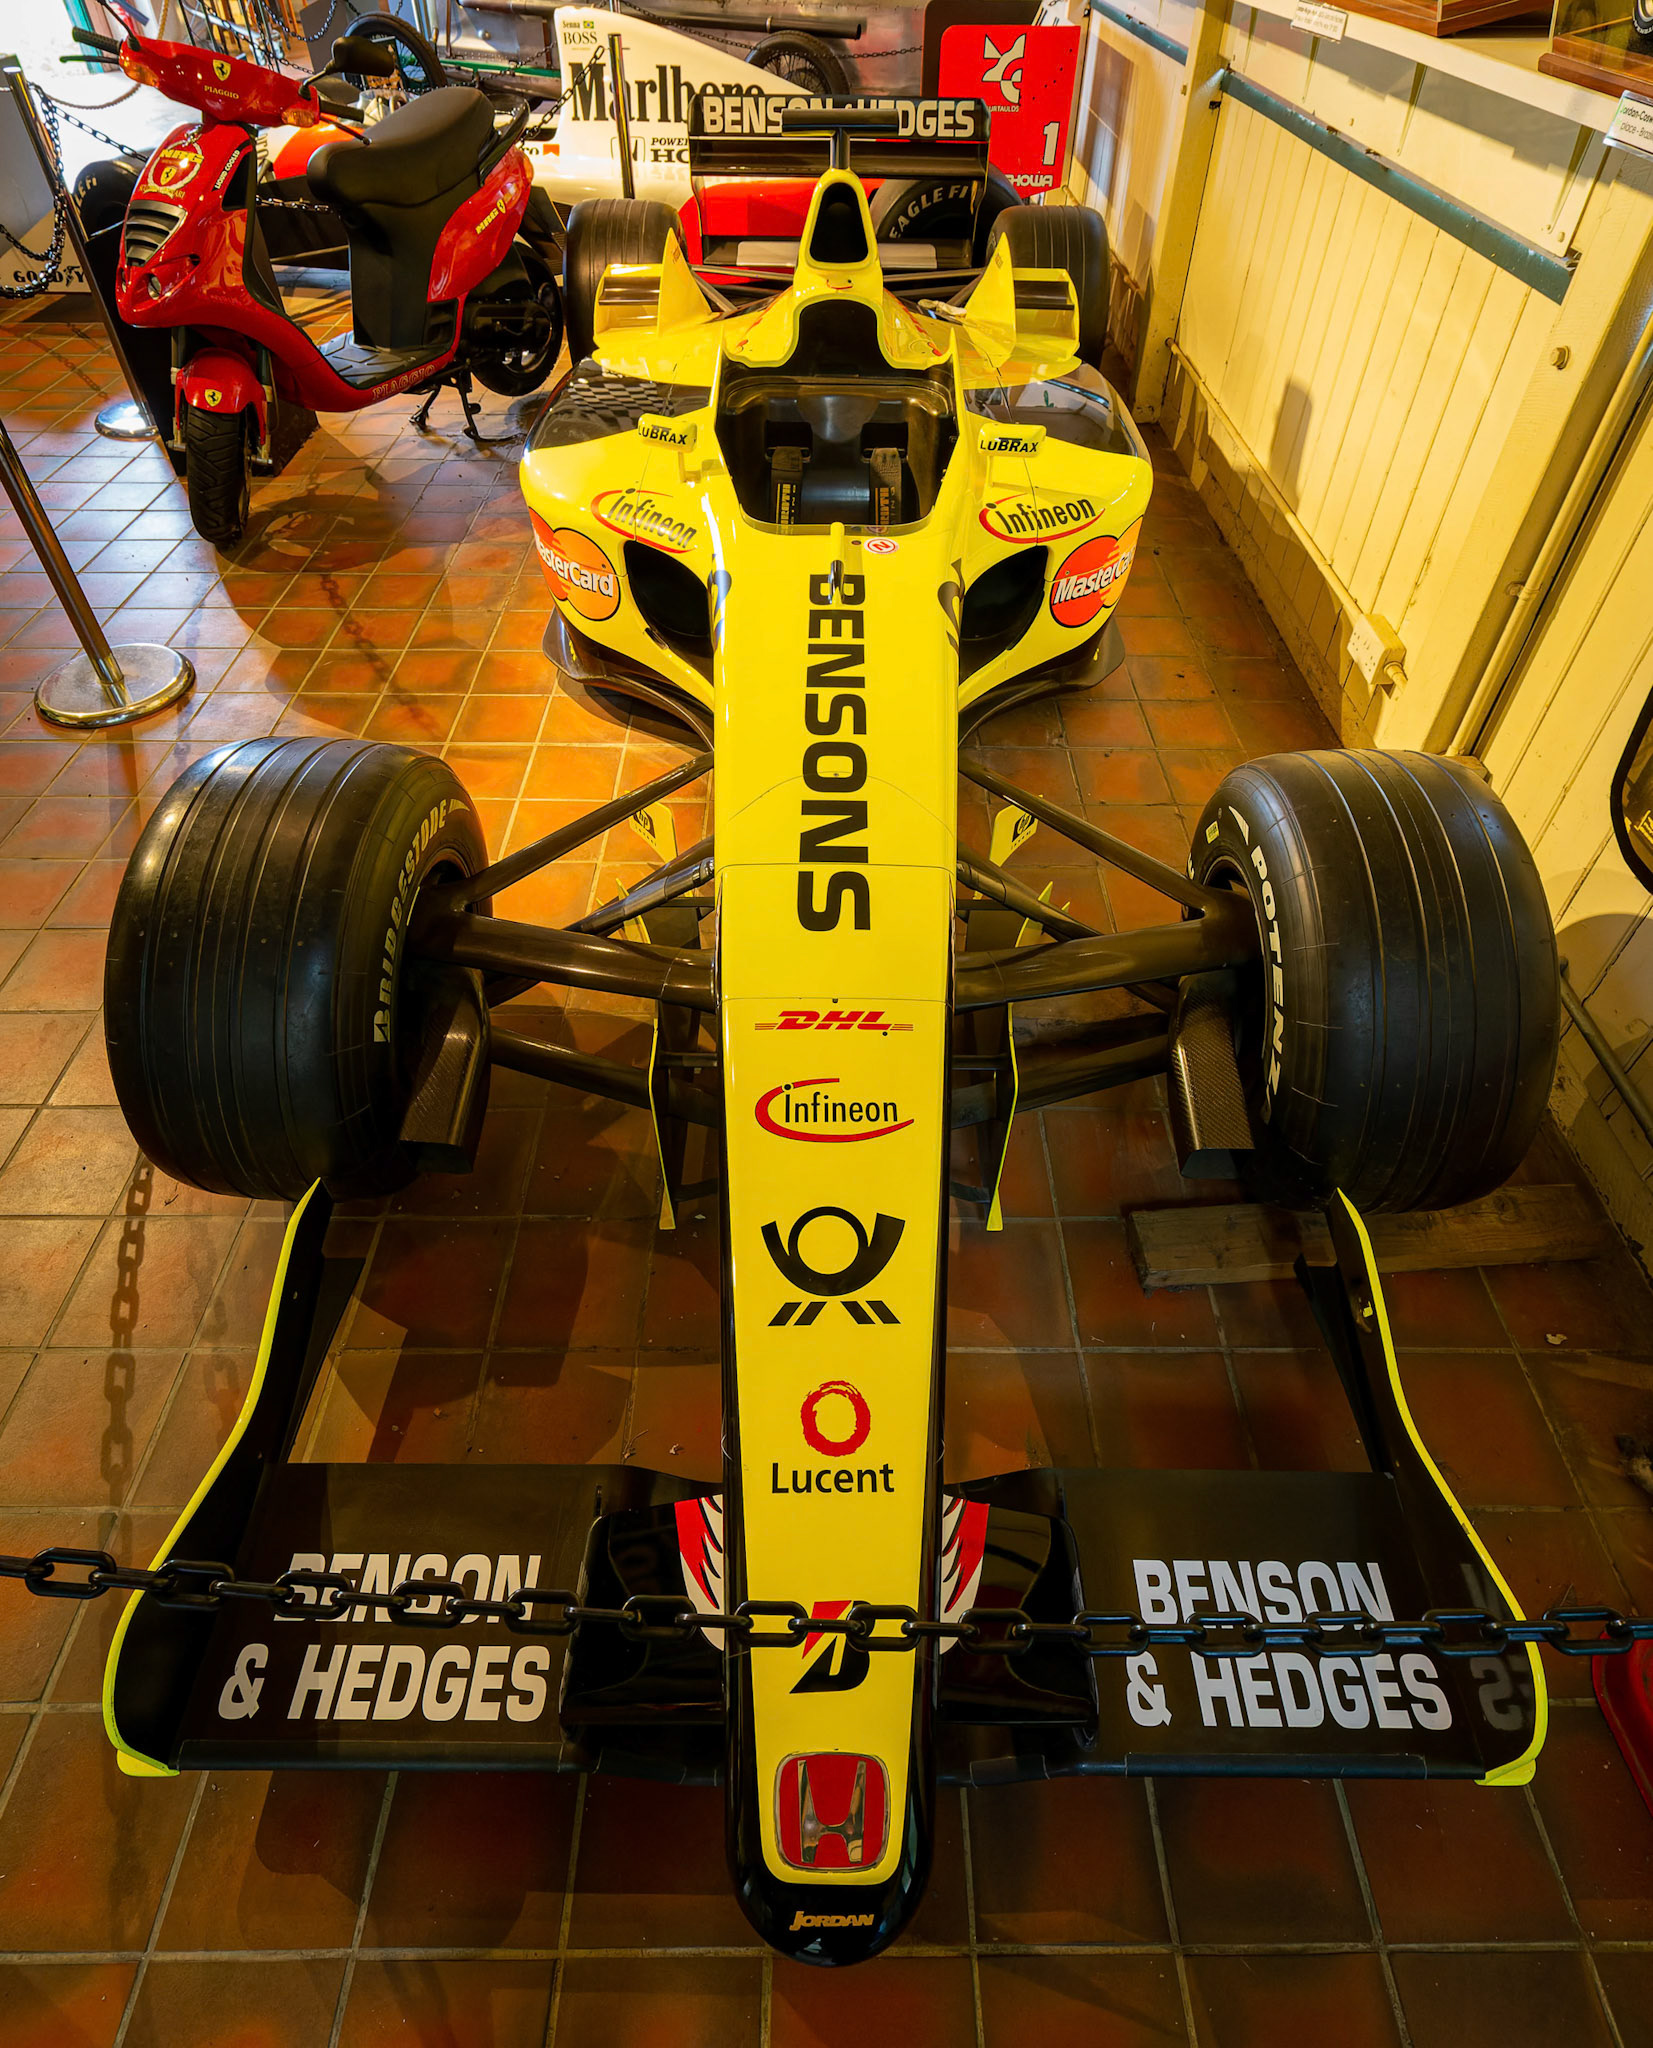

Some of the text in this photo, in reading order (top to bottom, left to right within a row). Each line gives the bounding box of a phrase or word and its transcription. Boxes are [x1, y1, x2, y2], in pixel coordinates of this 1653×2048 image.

[562, 20, 581, 29] Senna
[563, 31, 598, 45] BOSS
[203, 84, 240, 100] PIAGGIO
[1043, 121, 1061, 167] 1
[888, 186, 944, 240] EAGLE
[371, 363, 436, 401] PIAGGIO
[637, 424, 688, 446] LUBRAX
[979, 438, 1040, 453] LUBRAX
[796, 572, 872, 932] BENSONS
[373, 798, 448, 1043] BRIDGESTONE
[775, 1010, 897, 1032] DHL
[771, 1462, 895, 1495] Lucent
[1132, 1559, 1396, 1632] BENSON
[217, 1642, 551, 1723] & HEDGES
[1125, 1656, 1172, 1728] &
[1189, 1652, 1454, 1732] HEDGES
[789, 1909, 876, 1932] JORDAN
